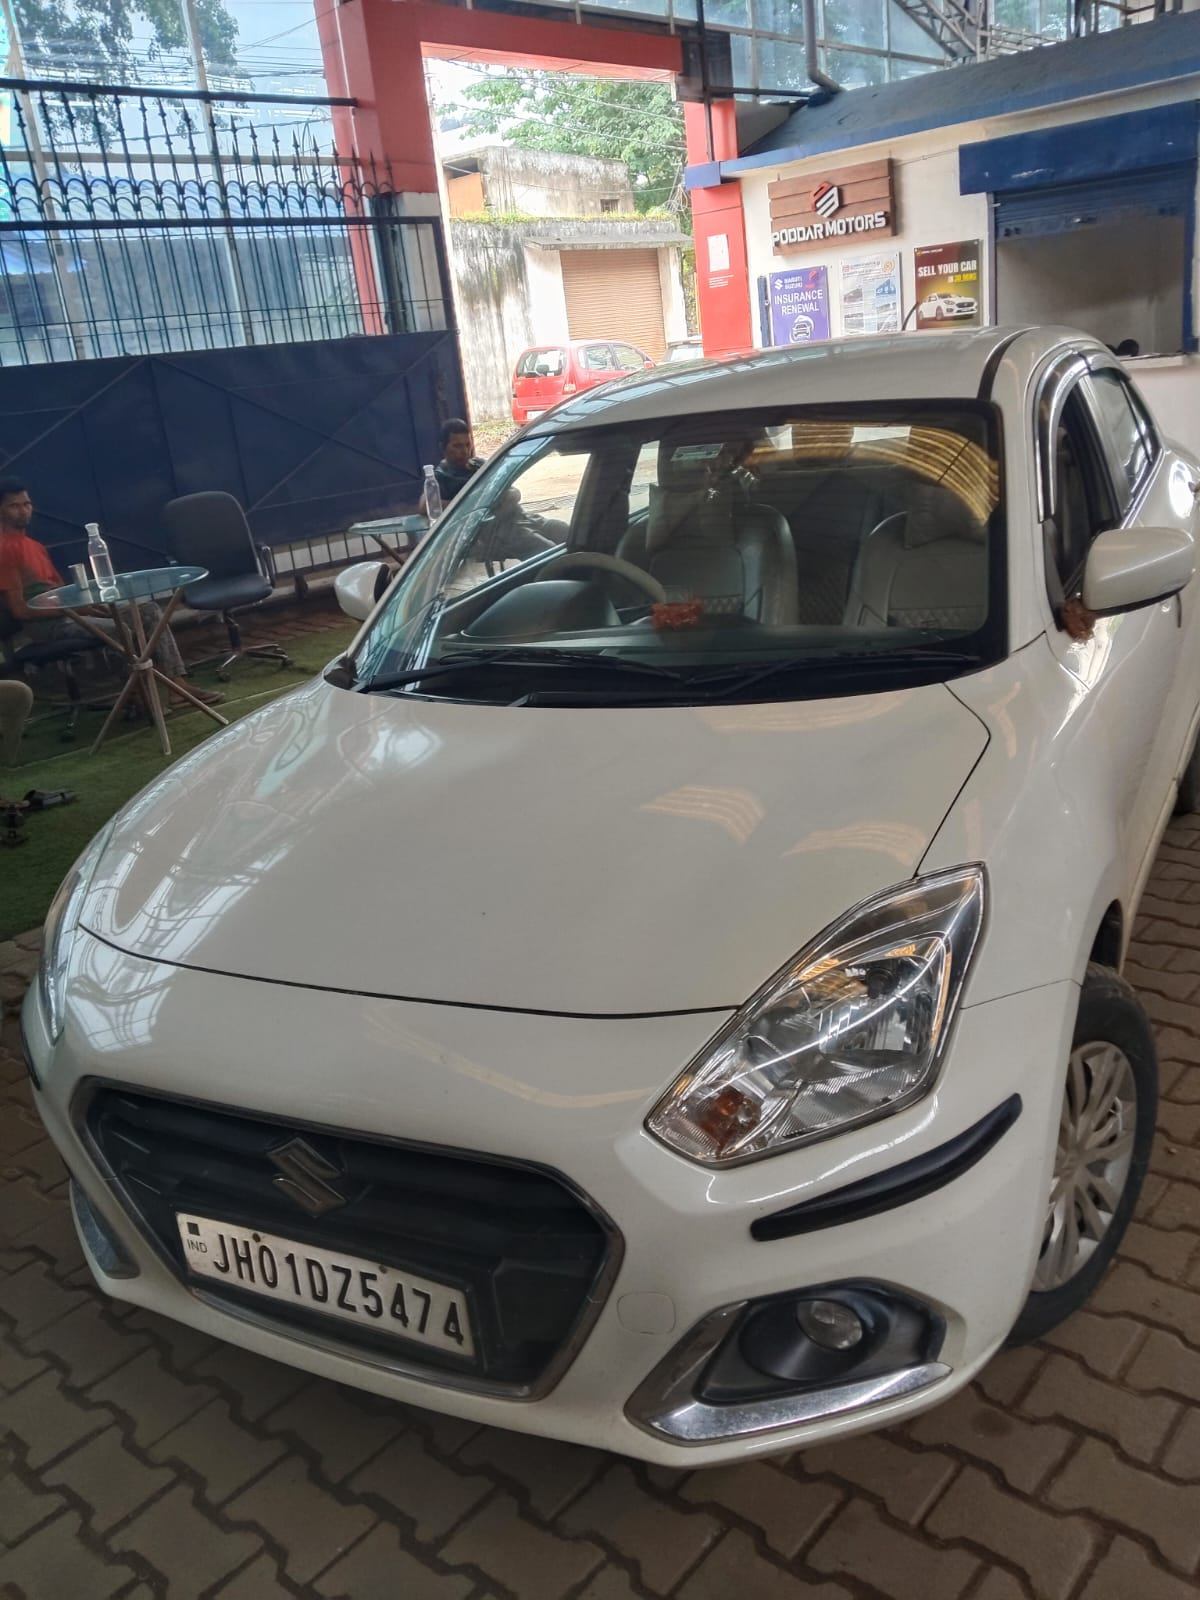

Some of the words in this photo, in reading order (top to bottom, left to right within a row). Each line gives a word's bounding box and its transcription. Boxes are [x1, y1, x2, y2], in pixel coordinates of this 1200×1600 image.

[771, 223, 824, 247] PODDAR
[825, 211, 886, 236] MOTORS
[918, 265, 937, 277] SELL
[938, 262, 959, 275] YOUR
[960, 260, 977, 272] CAR
[774, 289, 824, 305] INSURANCE
[781, 301, 820, 316] RENEWAL
[187, 1239, 208, 1254] IND
[213, 1233, 464, 1345] JH01DZ5474
